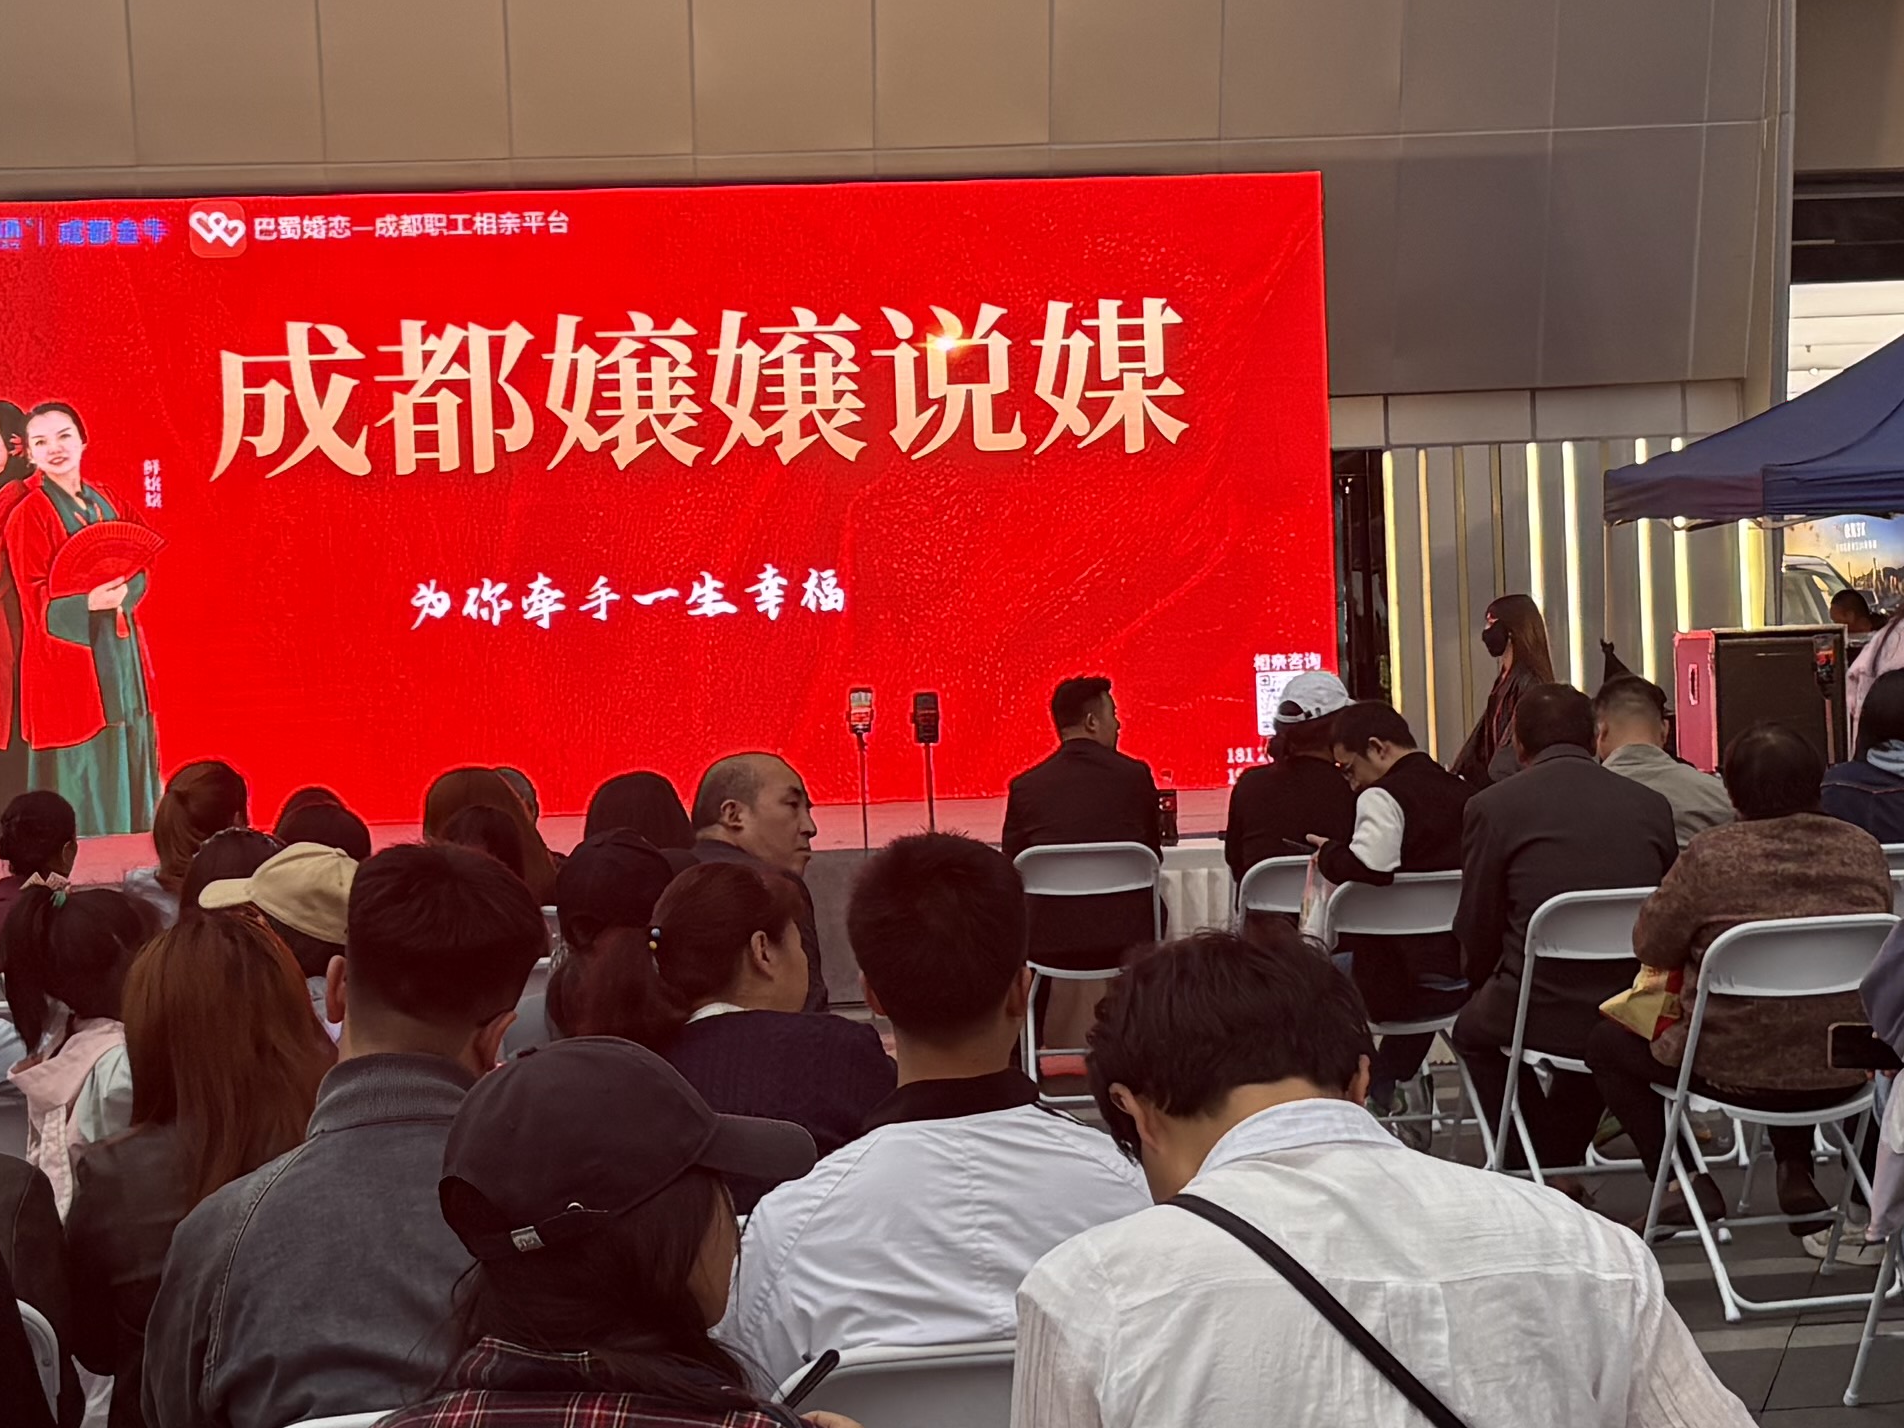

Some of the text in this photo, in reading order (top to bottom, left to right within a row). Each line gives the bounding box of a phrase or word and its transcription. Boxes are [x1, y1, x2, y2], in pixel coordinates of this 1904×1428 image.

[410, 563, 845, 630] 为你牵手一生幸福
[1253, 652, 1321, 670] 相亲咨询
